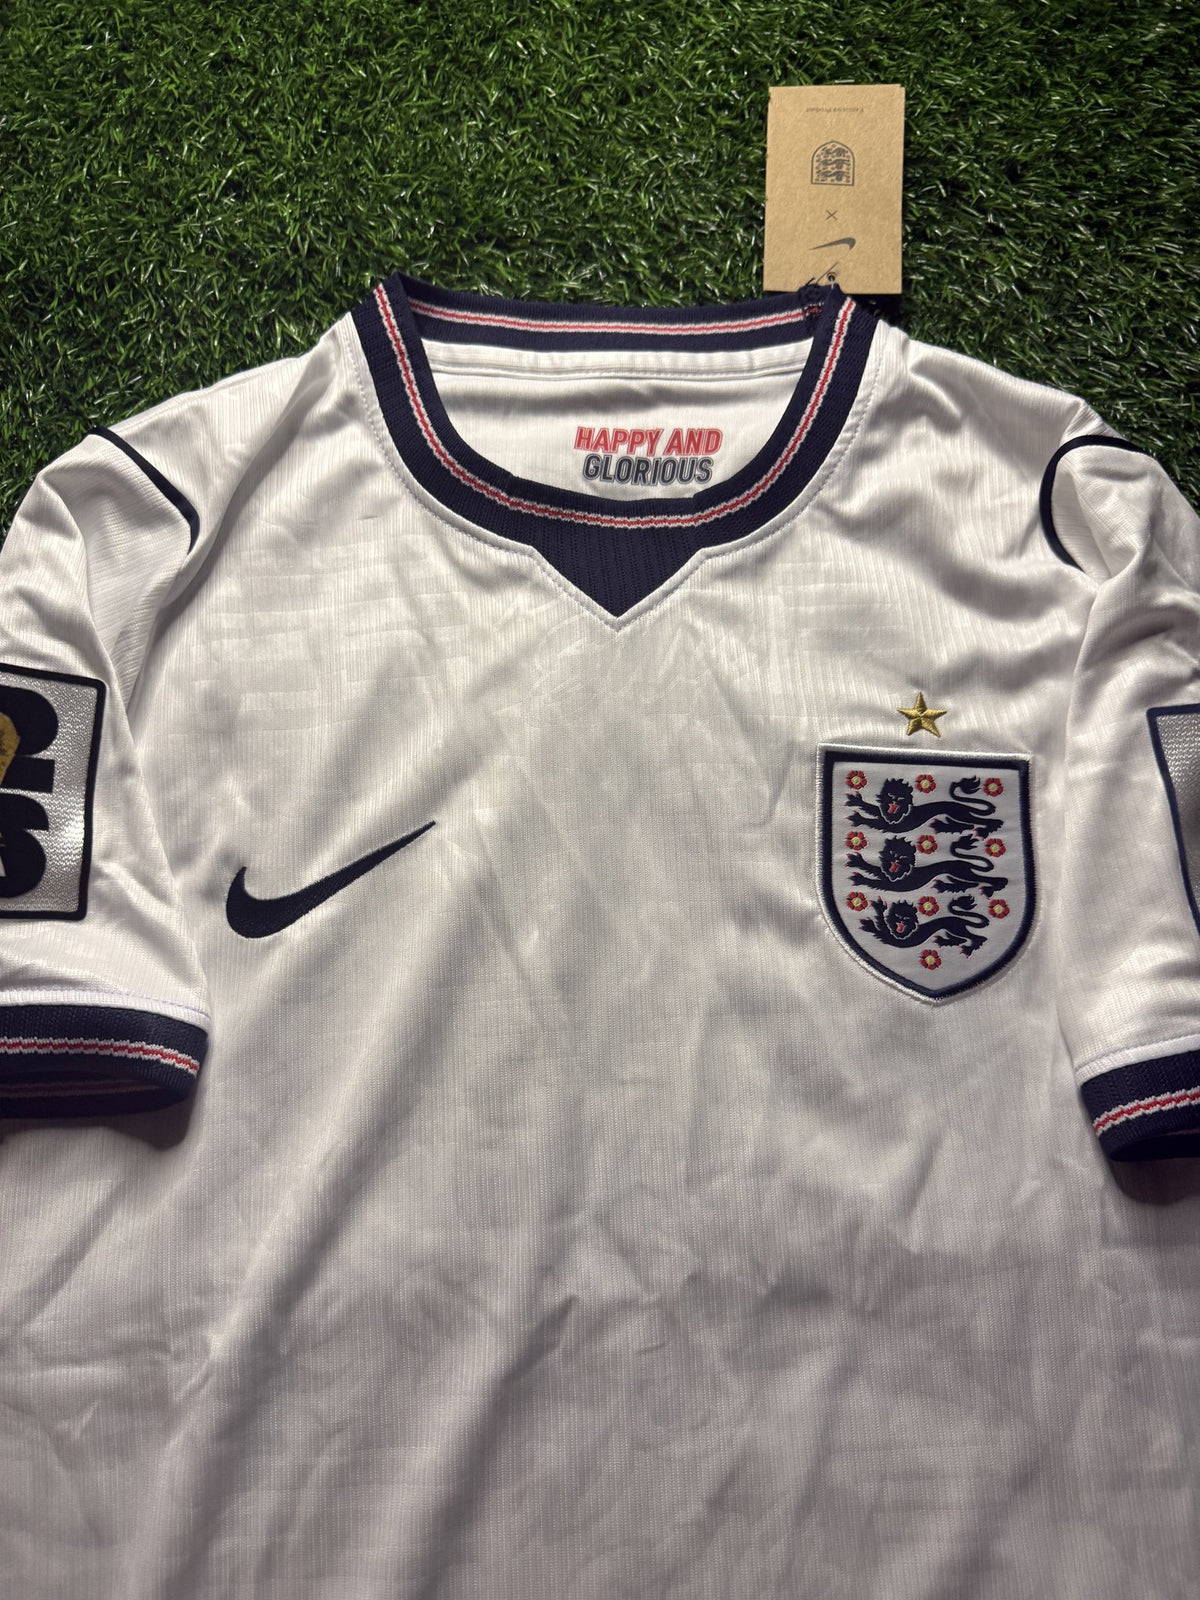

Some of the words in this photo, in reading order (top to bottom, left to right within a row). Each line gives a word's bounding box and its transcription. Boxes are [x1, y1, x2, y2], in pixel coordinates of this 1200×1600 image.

[574, 426, 664, 457] HAPPY
[663, 428, 723, 456] AND
[582, 453, 714, 487] GLORIOUS
